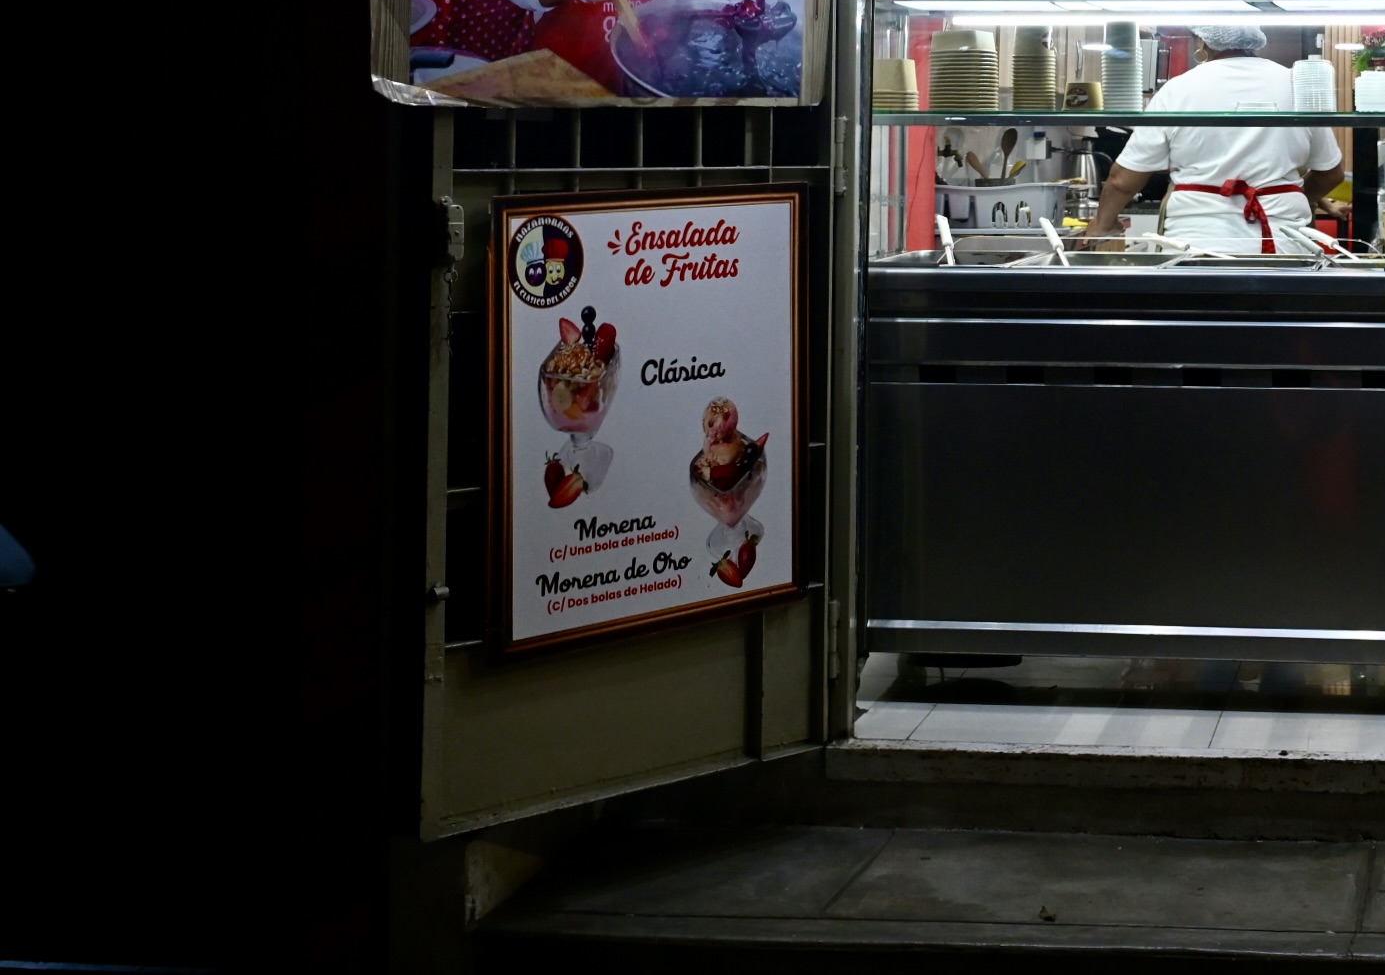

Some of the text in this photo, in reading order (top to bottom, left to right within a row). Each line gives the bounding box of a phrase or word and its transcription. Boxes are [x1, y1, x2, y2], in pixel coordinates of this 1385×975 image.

[624, 219, 740, 257] Ensalada
[624, 251, 740, 287] de Frutas
[513, 275, 578, 306] EL CLASICO DEL SABOR
[640, 355, 726, 387] Clásica
[569, 544, 593, 557] Una
[594, 540, 620, 553] bola
[621, 534, 636, 547] de
[636, 525, 680, 545] Helado)
[573, 515, 656, 542] Morena
[535, 551, 693, 597] Morena de Oro
[567, 596, 589, 609] Dos
[591, 589, 622, 604] bolas
[623, 586, 638, 598] de
[639, 574, 682, 594] Helado)
